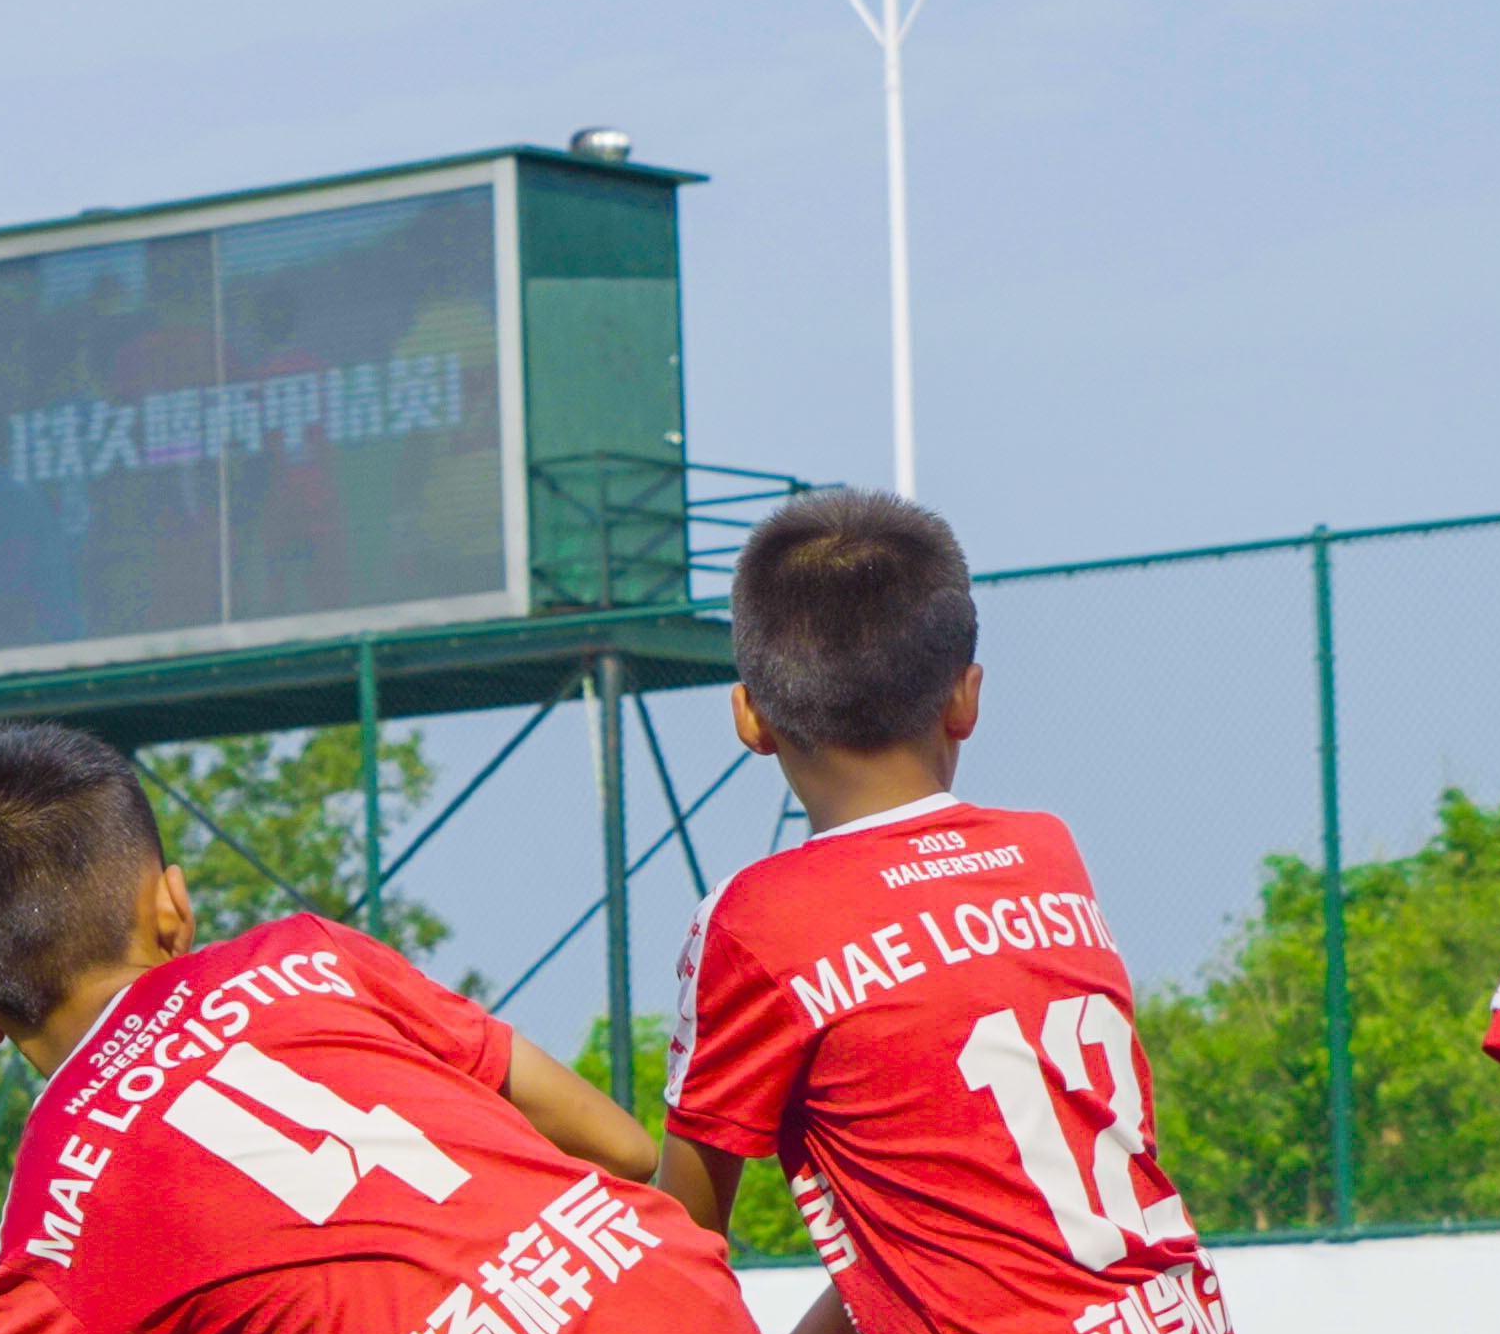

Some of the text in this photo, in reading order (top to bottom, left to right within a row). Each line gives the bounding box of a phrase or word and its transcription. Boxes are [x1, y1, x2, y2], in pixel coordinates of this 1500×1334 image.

[879, 845, 1024, 889] HALBERSTADT
[908, 830, 967, 855] 2019
[790, 923, 927, 1029] MAE
[65, 980, 193, 1115] HALBERSTADT
[89, 1013, 144, 1068] 2019
[26, 950, 356, 1269] MAE LOGISTICS
[163, 1042, 472, 1225] 4
[957, 994, 1198, 1272] 12
